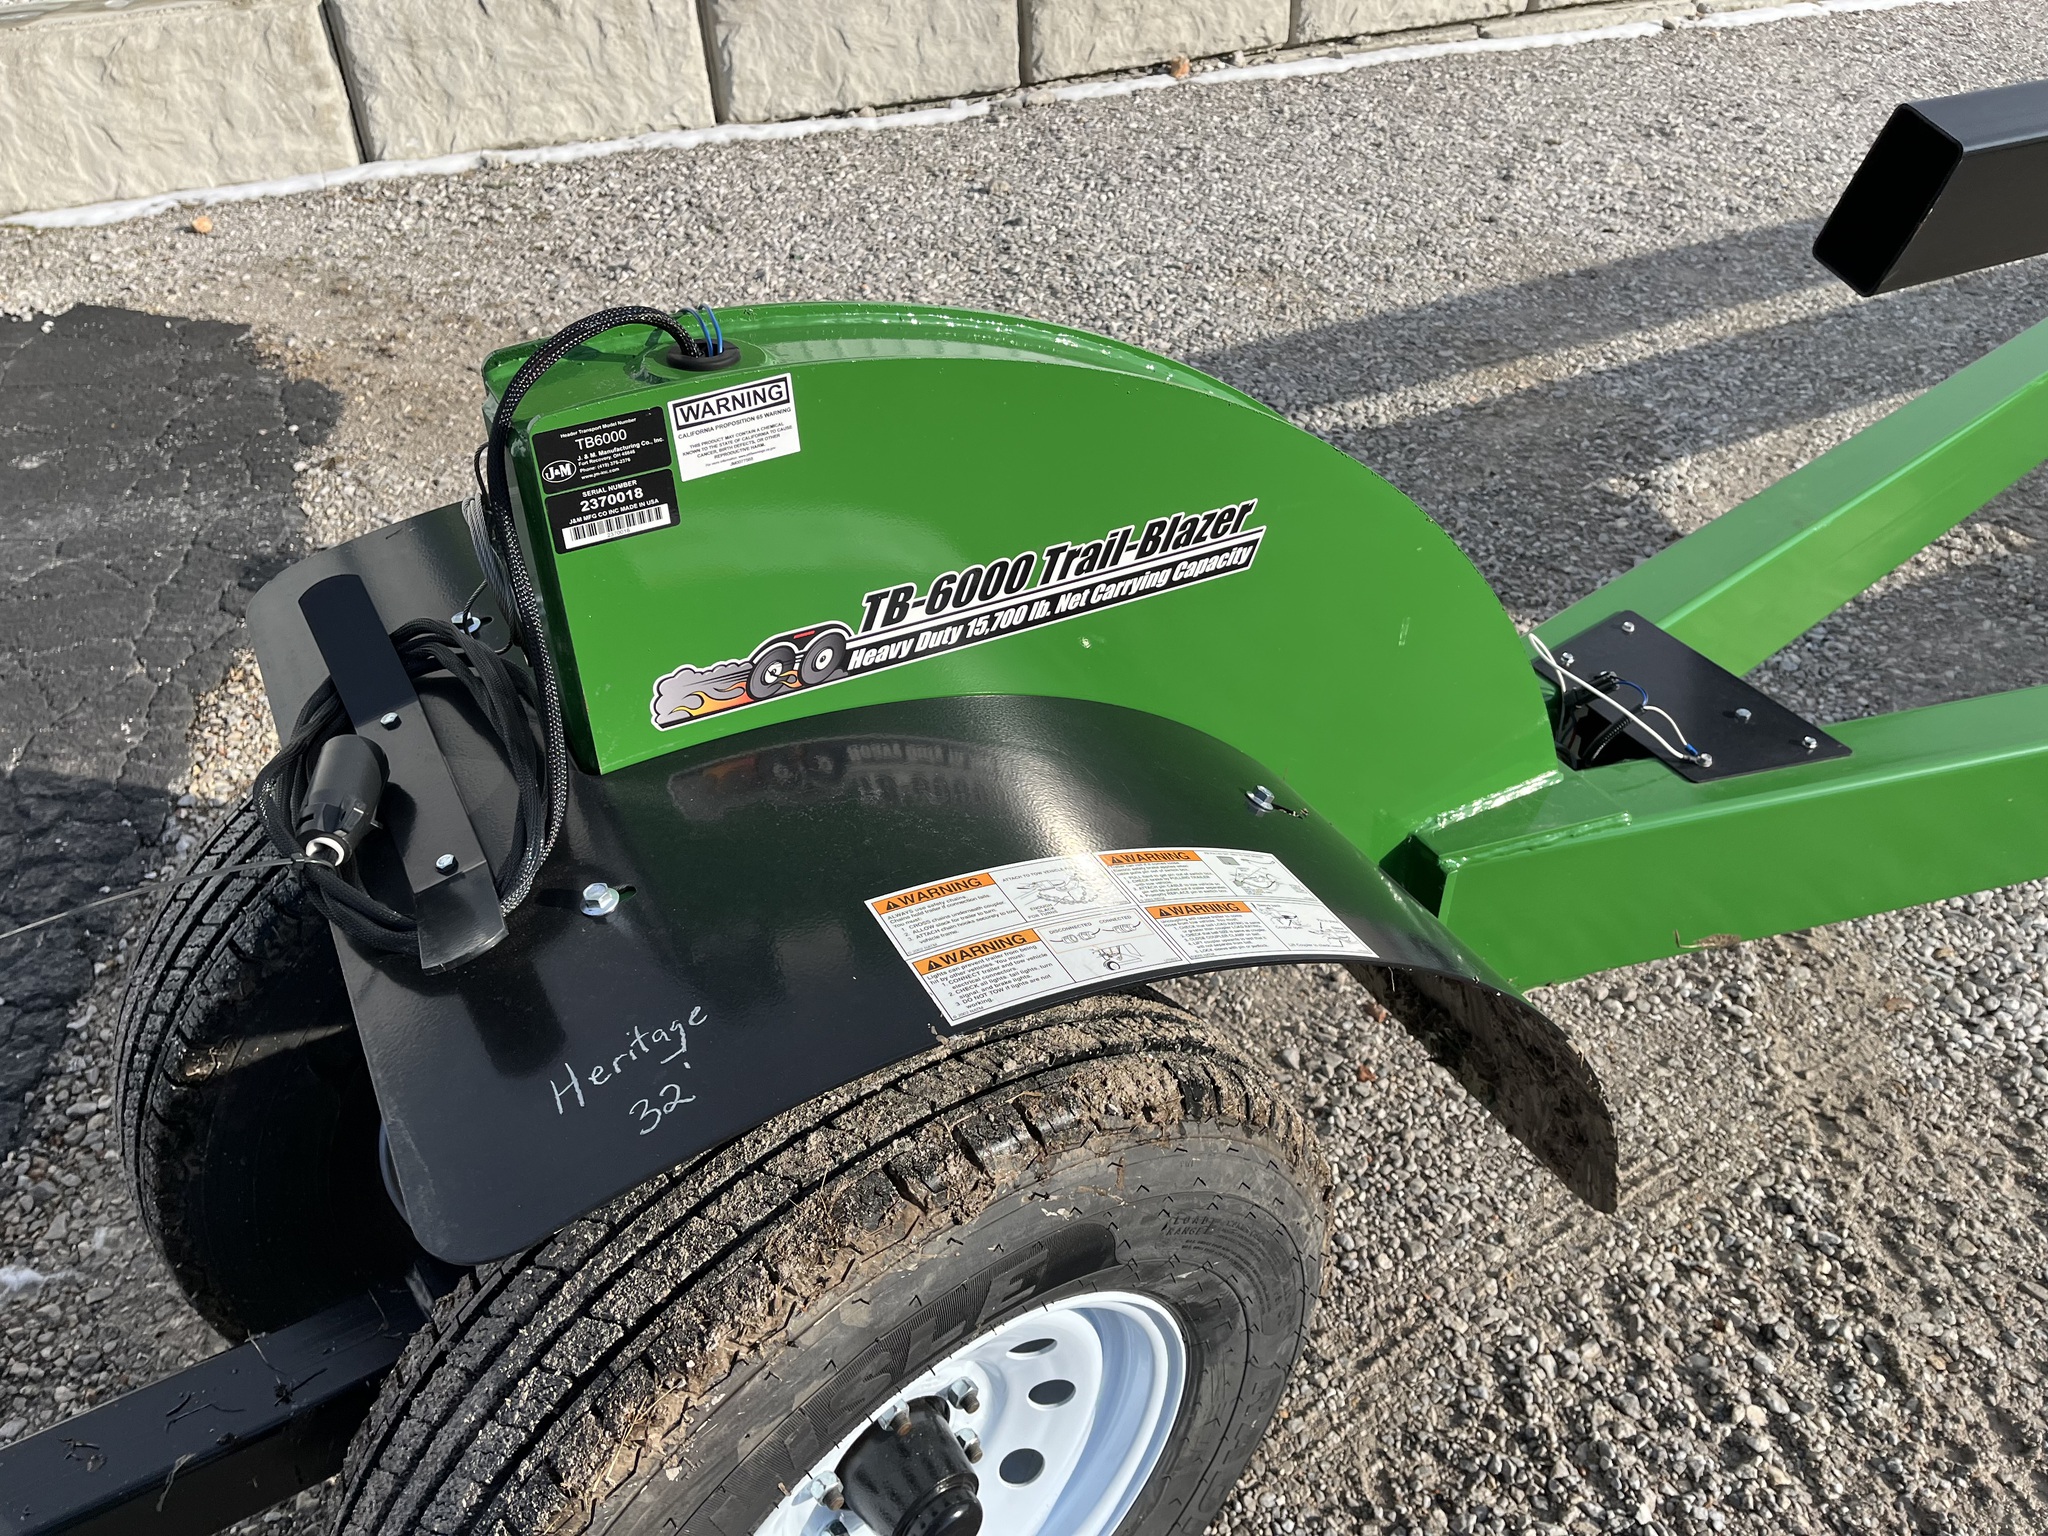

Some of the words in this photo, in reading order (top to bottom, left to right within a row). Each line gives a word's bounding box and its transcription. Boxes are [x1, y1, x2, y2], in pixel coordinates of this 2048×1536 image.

[679, 384, 783, 423] WARNING
[559, 430, 577, 438] Header
[578, 424, 601, 435] Transport
[602, 421, 616, 429] Model
[617, 416, 636, 425] Number
[677, 426, 713, 439] CALIFORNIA
[715, 416, 754, 430] PROPOSITION
[764, 407, 791, 418] WARNING
[701, 436, 723, 446] PRODUCT
[735, 428, 755, 437] CONTAIN
[760, 421, 783, 430] CHEMICAL
[575, 429, 627, 450] TB6000
[598, 441, 640, 457] Manufacturing
[682, 448, 700, 456] KNOWN
[741, 431, 768, 441] CALIFORNIA
[777, 424, 792, 432] CAUSE
[714, 446, 749, 459] REPRODUCTIVE
[545, 463, 571, 480] J&M
[581, 486, 607, 497] SERIAL
[607, 479, 637, 491] NUMBER
[580, 487, 643, 512] 2370018
[620, 503, 637, 511] MADE
[862, 554, 1035, 632] TB-6000
[1040, 501, 1255, 585] Trail-Blazer
[847, 638, 915, 670] Heavy
[914, 624, 964, 652] Duty
[966, 605, 1028, 638] 15,700
[1028, 600, 1050, 622] lb.
[1055, 590, 1091, 614] Net
[1091, 567, 1172, 604] Carrying
[1173, 545, 1253, 581] Capacity
[1121, 852, 1190, 863] WARNING
[898, 878, 982, 905] WARNING
[885, 909, 914, 919] ALWAYS
[926, 900, 945, 908] safety
[888, 915, 910, 923] Chains
[945, 897, 977, 907] connection
[907, 920, 931, 928] CROSS
[950, 906, 983, 916] underneath
[1168, 903, 1240, 916] WARNING
[911, 925, 935, 933] ALLOW
[914, 929, 940, 938] ATTACH
[975, 913, 999, 922] securely
[1048, 922, 1092, 933] DISCONNECTED
[1098, 915, 1131, 923] CONNECTED
[939, 934, 1027, 965] WARNING
[926, 971, 947, 980] Lights
[960, 959, 985, 969] prevent
[984, 953, 1003, 961] trailer
[1019, 944, 1037, 952] being
[947, 971, 981, 984] CONNECT
[981, 965, 1000, 973] trailer
[1026, 952, 1047, 961] vehicle
[948, 970, 966, 978] other
[950, 977, 981, 989] electrical
[993, 979, 1012, 987] brake
[1010, 980, 1029, 988] lights
[954, 984, 979, 993] CHECK
[550, 1006, 708, 1115] Heritage
